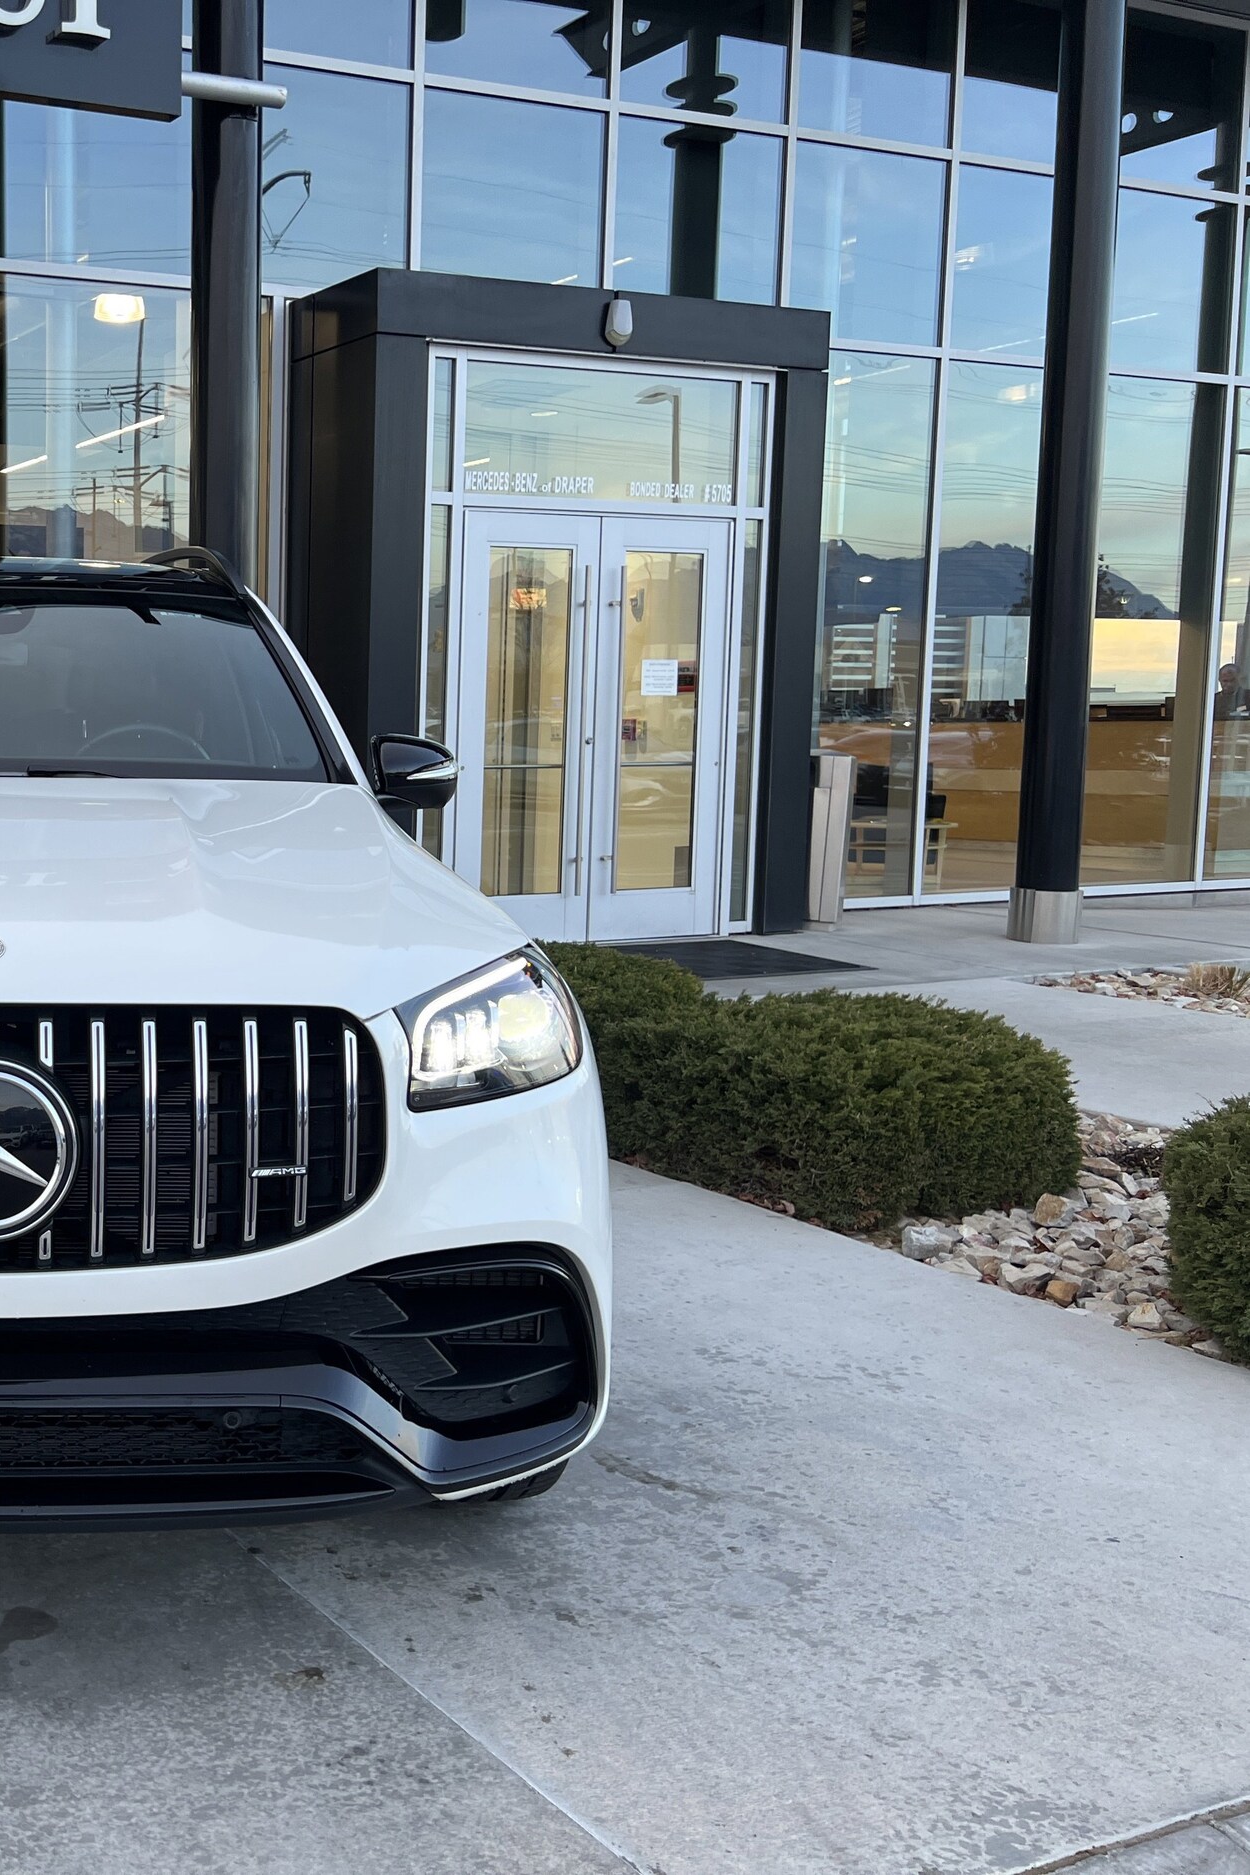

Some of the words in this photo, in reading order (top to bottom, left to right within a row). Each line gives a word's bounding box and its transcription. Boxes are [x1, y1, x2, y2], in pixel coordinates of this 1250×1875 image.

[542, 482, 551, 492] of
[554, 476, 594, 494] DRAPER
[630, 482, 661, 497] BONDED
[664, 484, 694, 498] DEALER
